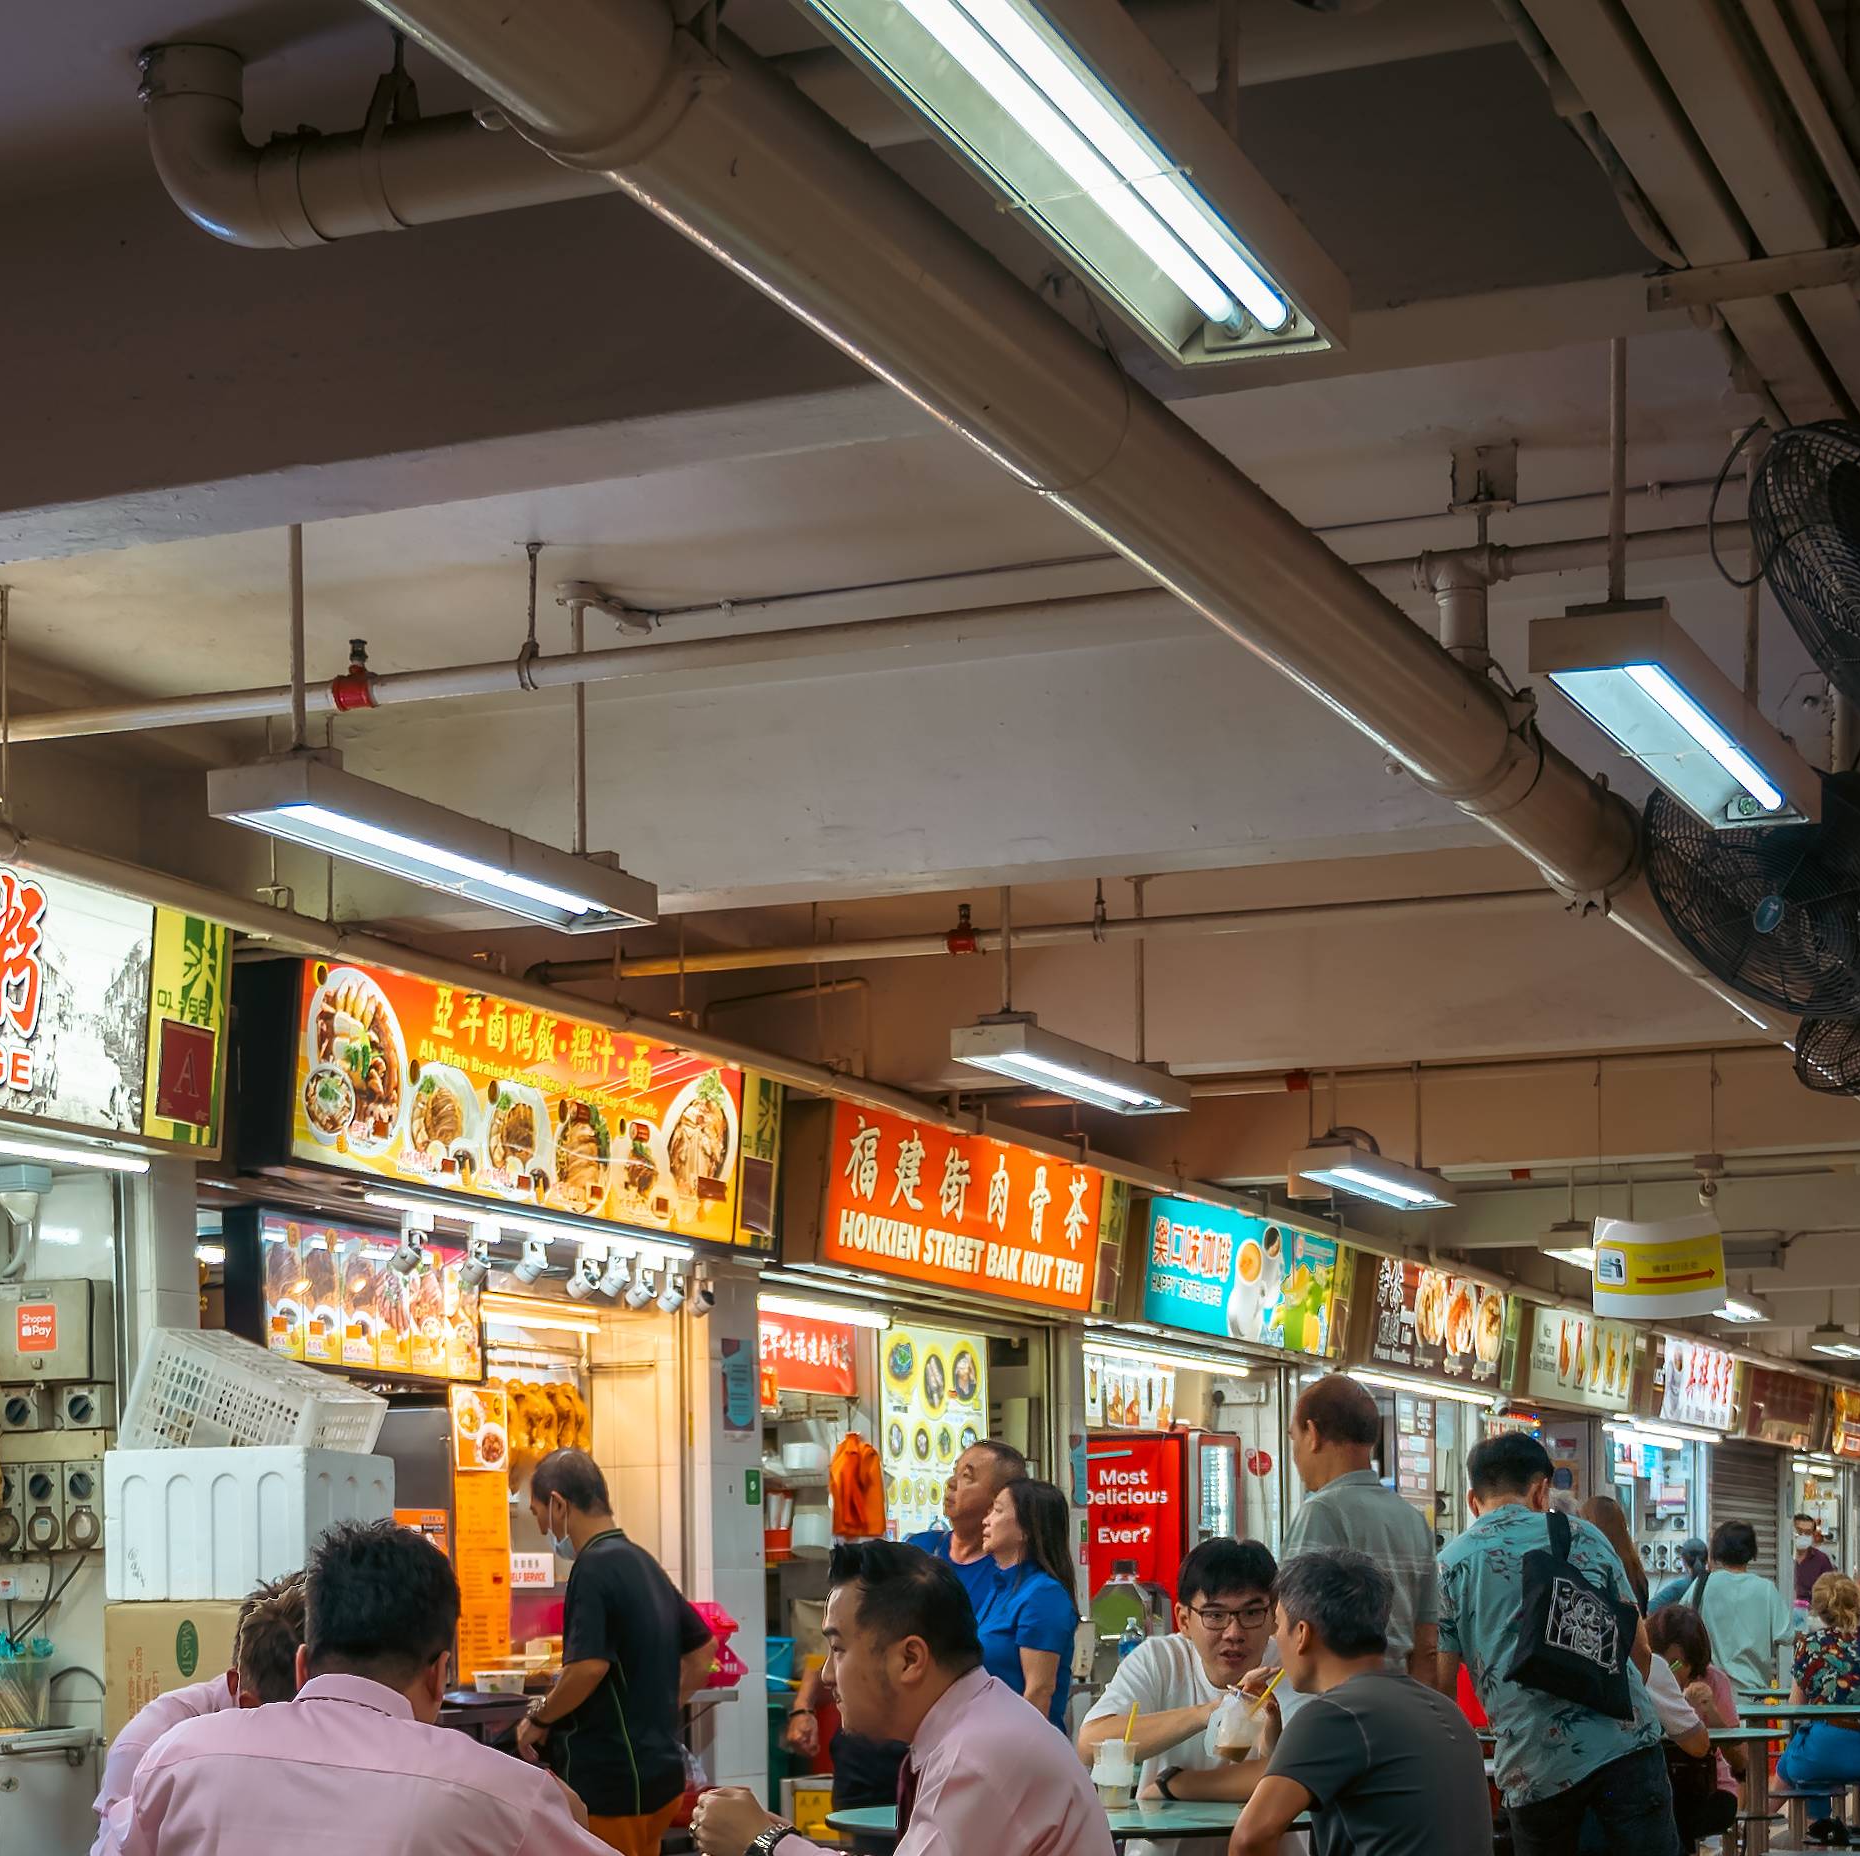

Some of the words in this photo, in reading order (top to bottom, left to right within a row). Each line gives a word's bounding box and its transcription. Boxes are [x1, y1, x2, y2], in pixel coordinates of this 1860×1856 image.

[173, 1046, 201, 1099] A
[418, 1039, 436, 1060] Ah
[472, 1056, 513, 1080] Braised
[512, 1066, 538, 1088] Duck
[540, 1075, 563, 1094] Rice
[625, 1098, 659, 1121] Noodle
[844, 1114, 1089, 1251] 福建街肉骨茶
[838, 1208, 922, 1262] HOKKIEN
[922, 1228, 985, 1275] STREET
[985, 1242, 1022, 1282] BAK
[1021, 1250, 1056, 1289] KUT
[1055, 1258, 1084, 1295] TEH
[1150, 1271, 1177, 1297] HAPPY
[1177, 1279, 1201, 1302] TASTE
[21, 1313, 52, 1326] Shopee
[31, 1325, 52, 1338] Pay
[1098, 1469, 1149, 1487] Most
[1097, 1526, 1152, 1544] Ever?
[523, 1571, 547, 1583] SERVICE
